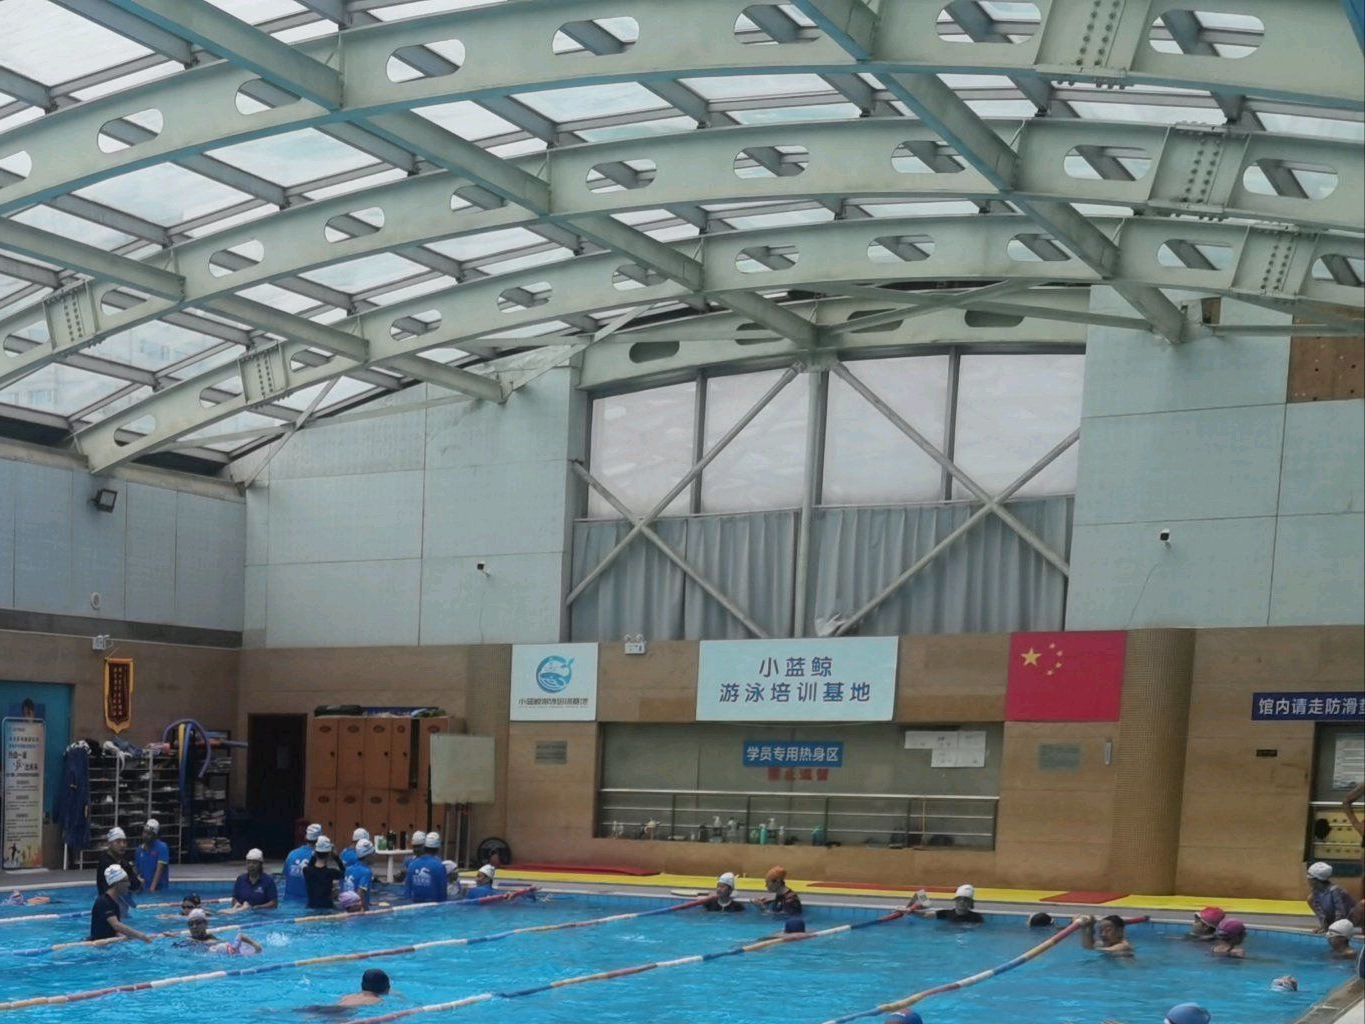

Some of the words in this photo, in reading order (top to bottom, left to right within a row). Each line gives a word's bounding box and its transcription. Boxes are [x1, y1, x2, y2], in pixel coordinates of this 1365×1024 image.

[759, 656, 833, 678] 小蓝鲸
[719, 681, 871, 703] 游泳培训基地
[746, 746, 839, 762] 学员专用热身区
